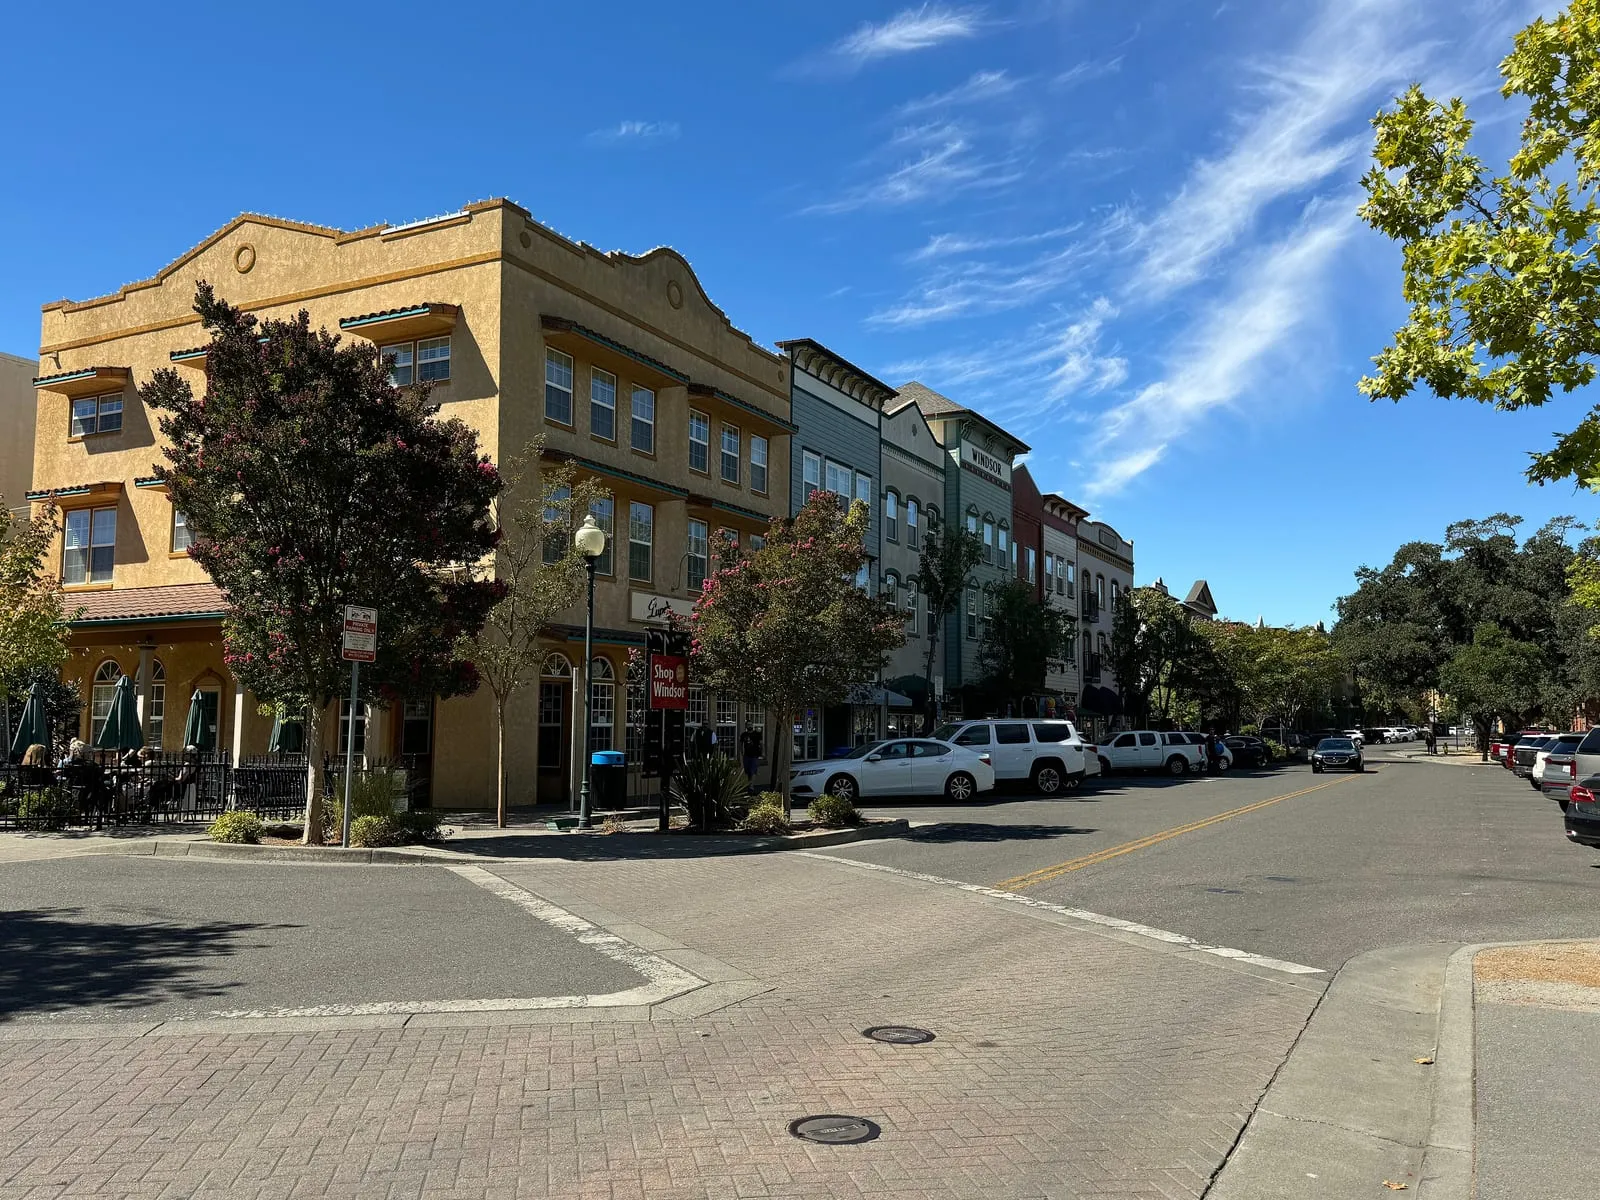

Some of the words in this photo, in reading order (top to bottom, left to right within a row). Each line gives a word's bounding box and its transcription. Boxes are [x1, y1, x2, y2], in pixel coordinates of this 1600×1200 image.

[972, 448, 1002, 477] WINDSOR
[654, 664, 674, 683] Shop
[653, 681, 686, 698] Windsor
